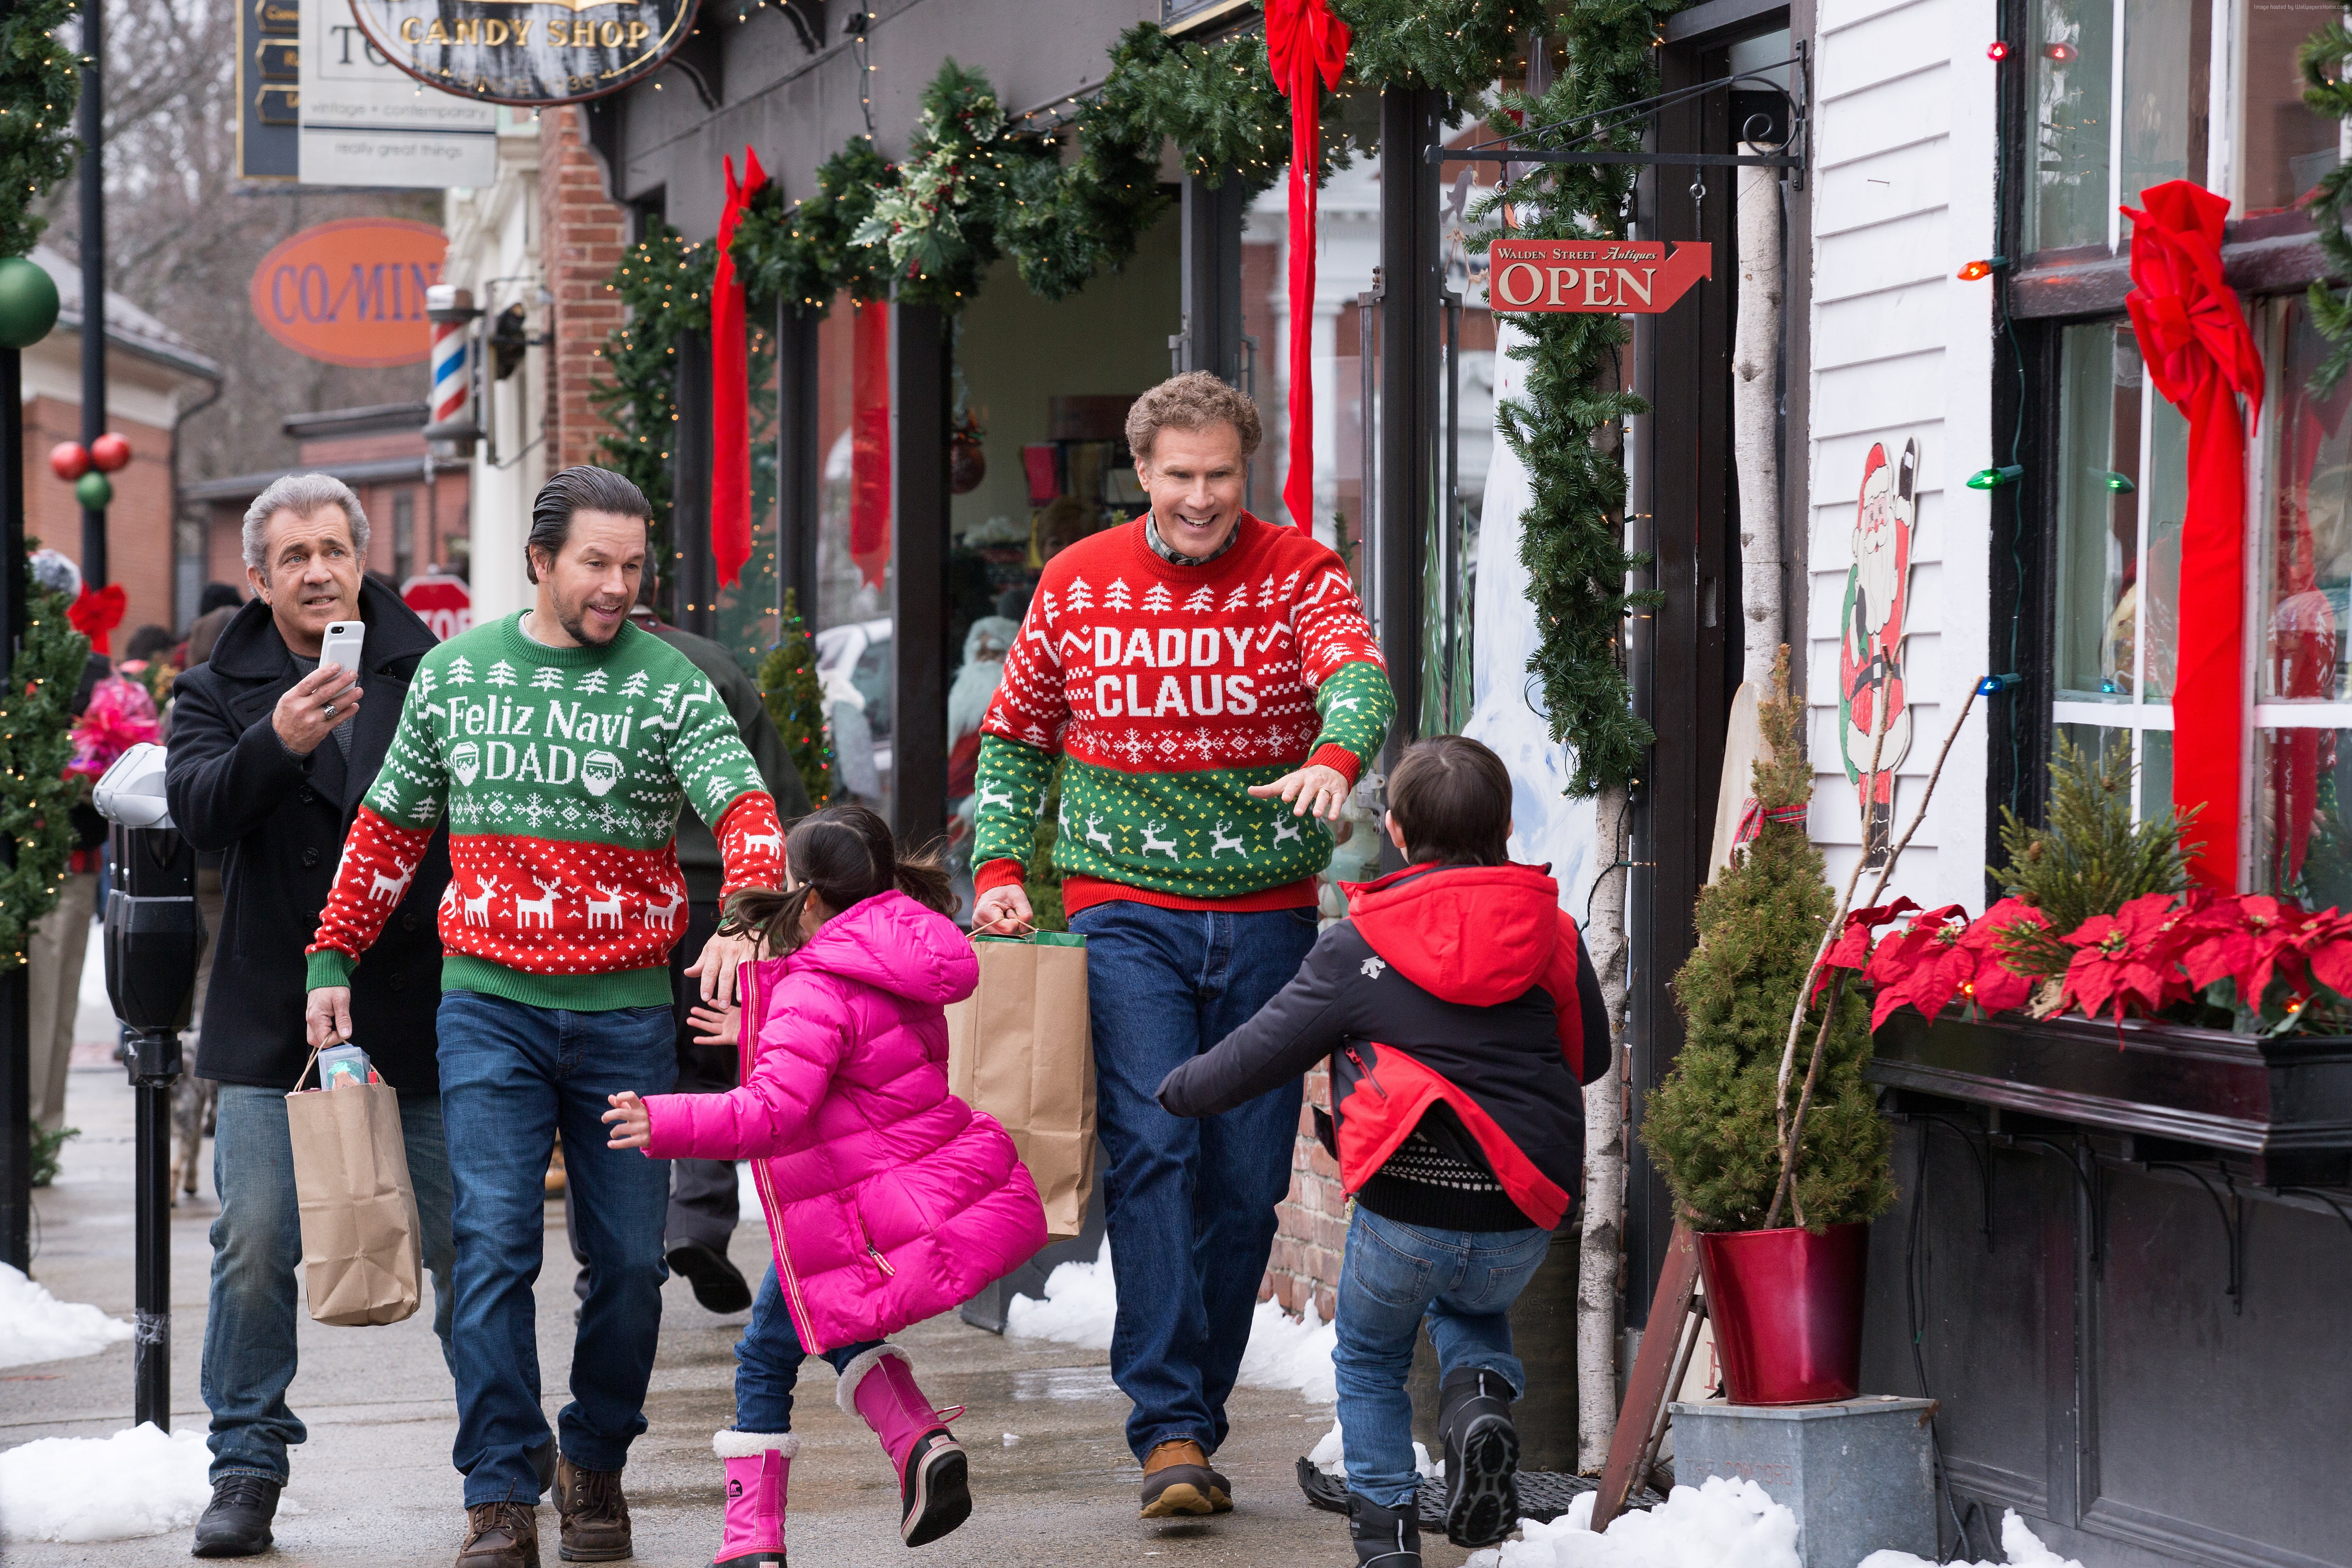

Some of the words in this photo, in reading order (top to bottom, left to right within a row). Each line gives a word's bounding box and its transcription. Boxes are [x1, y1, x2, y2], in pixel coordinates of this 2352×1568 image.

[401, 18, 533, 46] CANDY
[548, 20, 650, 48] SHOP
[310, 102, 365, 118] vintage
[383, 103, 488, 120] contemporary
[335, 143, 373, 156] really
[377, 143, 416, 158] great
[421, 144, 462, 160] things
[1497, 248, 1547, 260] WALDEN
[1553, 248, 1597, 260] STREET
[1602, 246, 1657, 263] Antiques
[1498, 262, 1657, 306] OPEN
[1094, 626, 1254, 668] DADDY
[1095, 674, 1258, 717] CLAUS
[447, 695, 534, 739] Feliz
[543, 699, 634, 749] Navi
[485, 741, 576, 784] DAD
